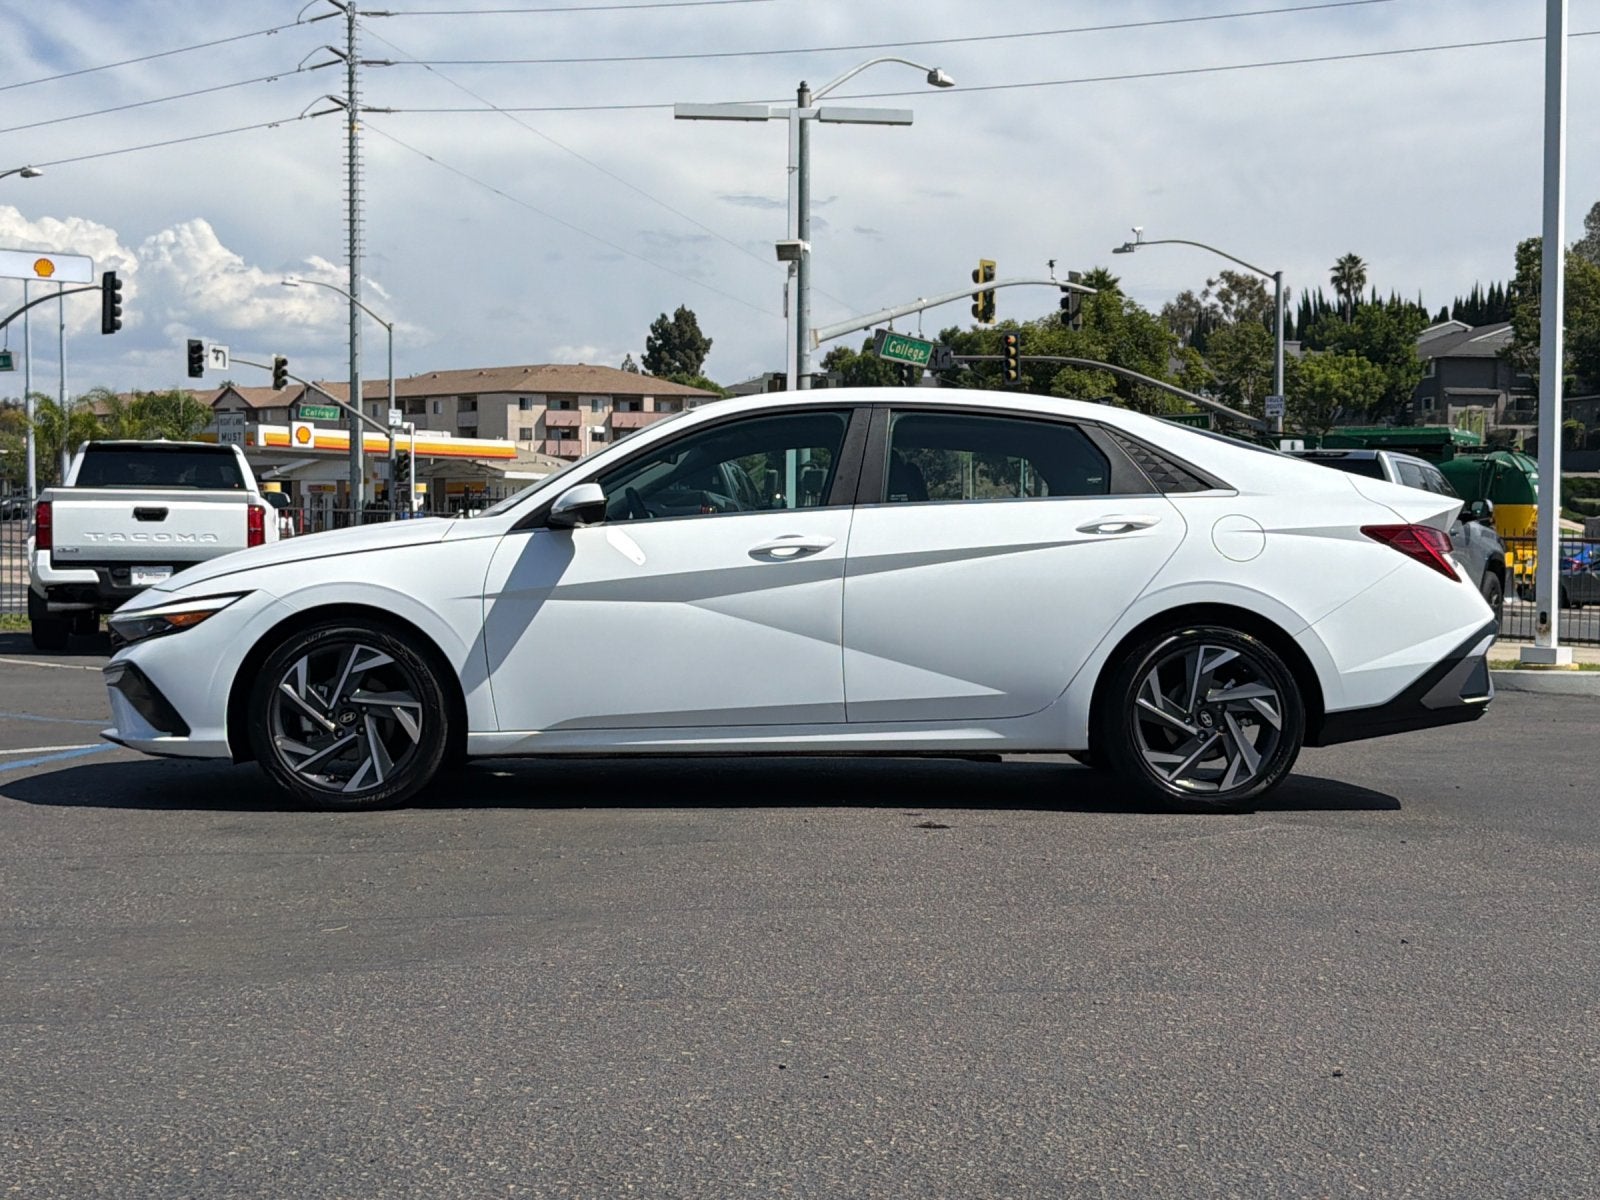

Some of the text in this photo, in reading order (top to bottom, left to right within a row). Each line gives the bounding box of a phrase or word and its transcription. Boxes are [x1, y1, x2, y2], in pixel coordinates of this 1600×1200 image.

[889, 340, 925, 361] College
[305, 408, 334, 418] College
[221, 431, 242, 441] MUST
[83, 531, 218, 543] TACOMA
